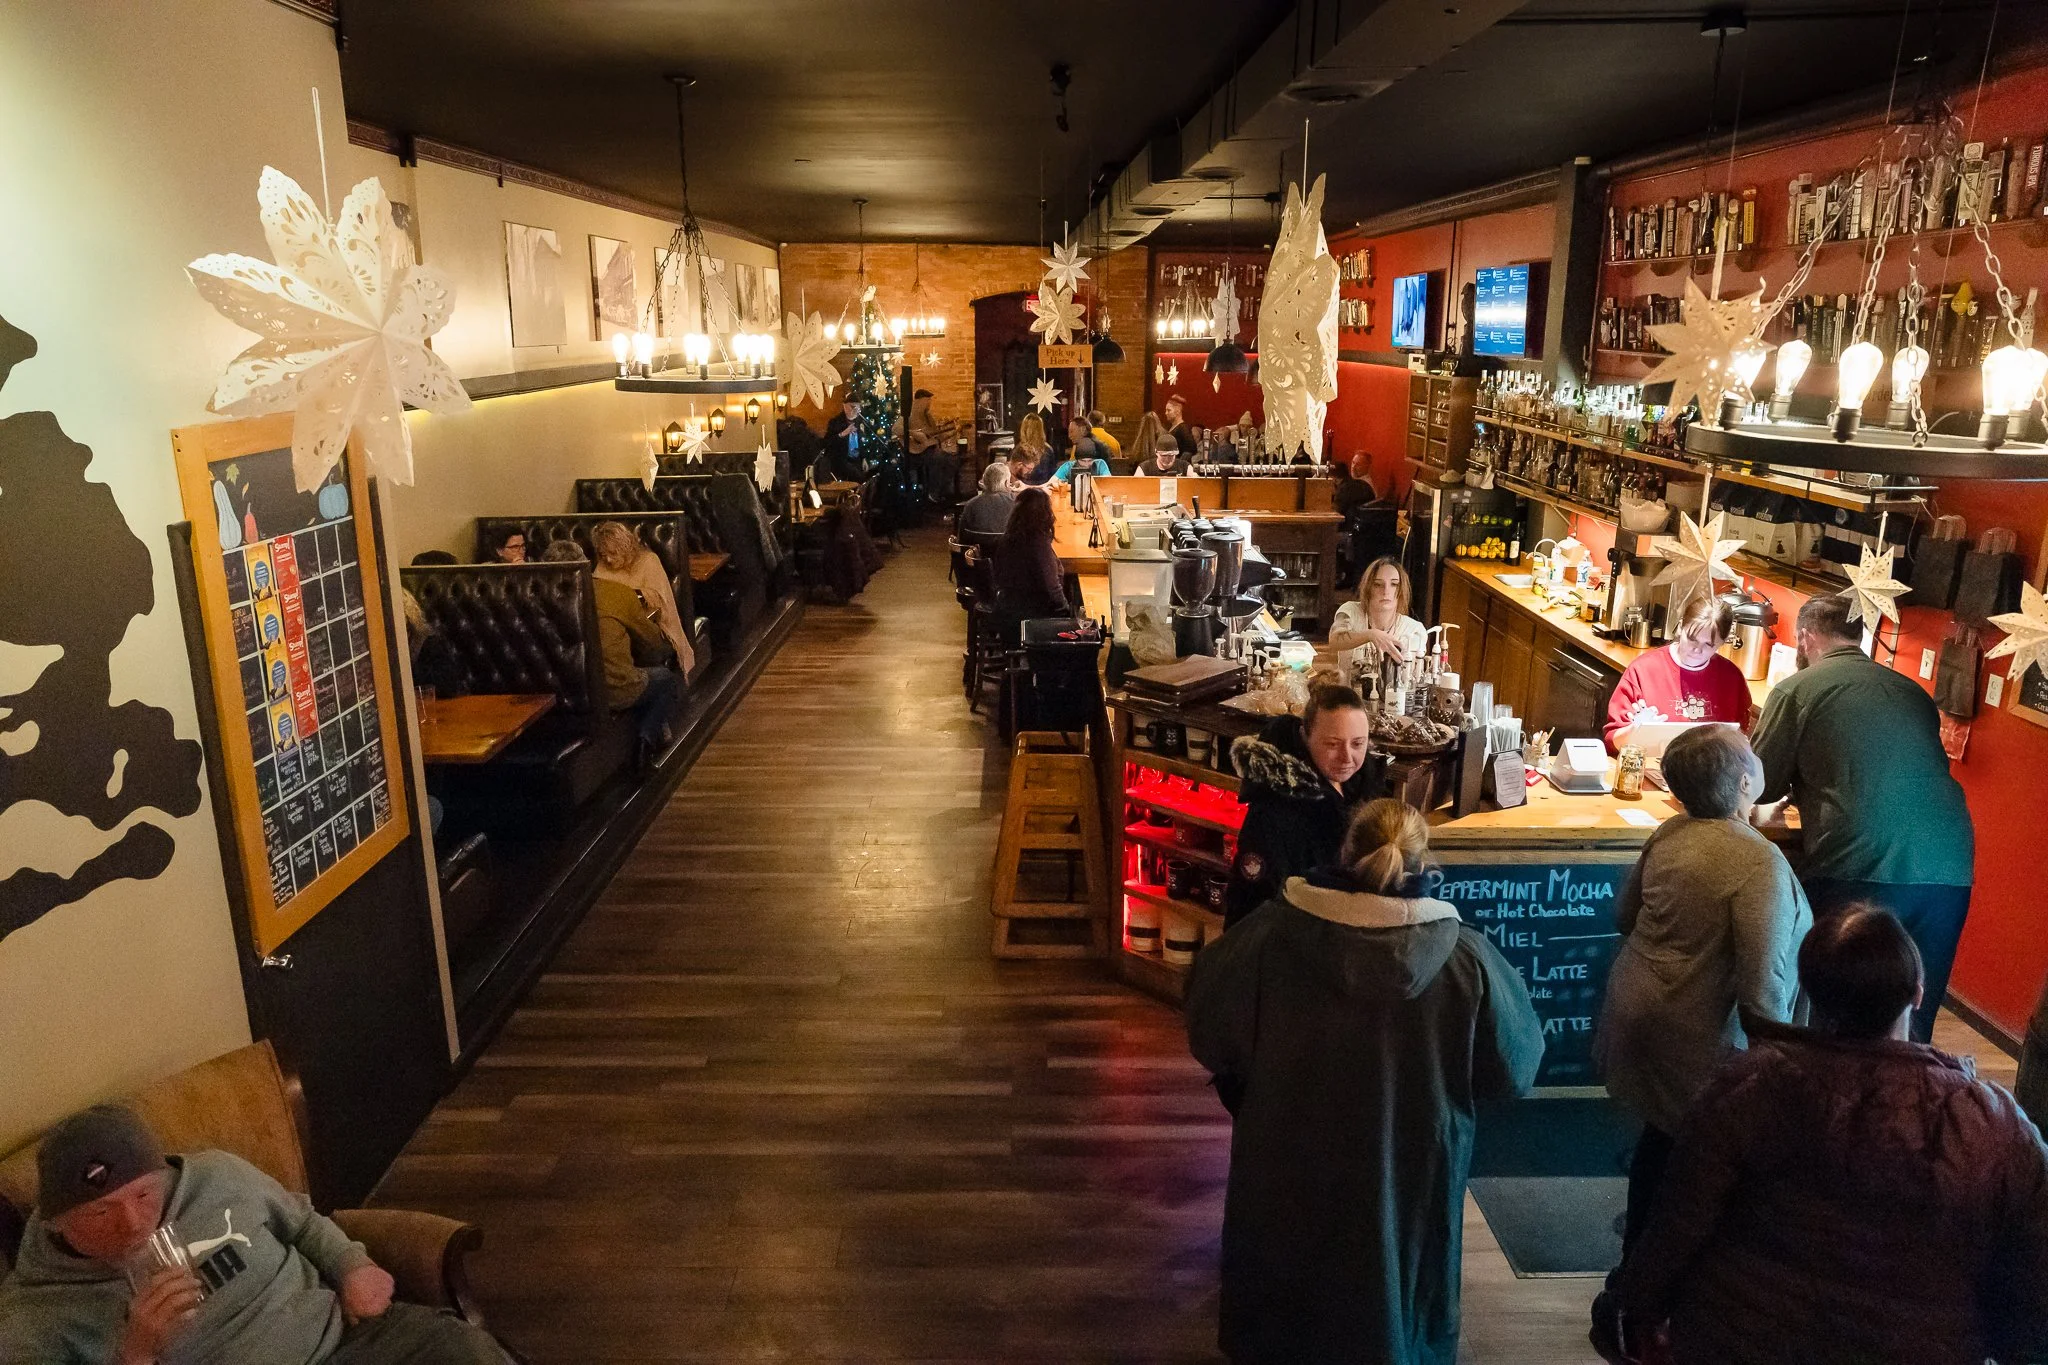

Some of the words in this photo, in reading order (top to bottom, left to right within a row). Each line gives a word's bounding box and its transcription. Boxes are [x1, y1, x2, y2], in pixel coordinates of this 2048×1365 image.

[2030, 145, 2043, 175] FURIOUS
[1046, 347, 1063, 357] Pick
[1065, 350, 1076, 358] up
[1050, 357, 1070, 365] Here
[1426, 870, 1542, 901] PEPPERMINT
[1547, 868, 1615, 902] MOCHA
[1475, 908, 1493, 918] or
[1497, 904, 1526, 919] Hot
[1529, 903, 1596, 918] Chocolate
[1482, 923, 1544, 948] MIEL
[1532, 956, 1588, 982] LATTE
[1543, 1016, 1593, 1036] ATTE
